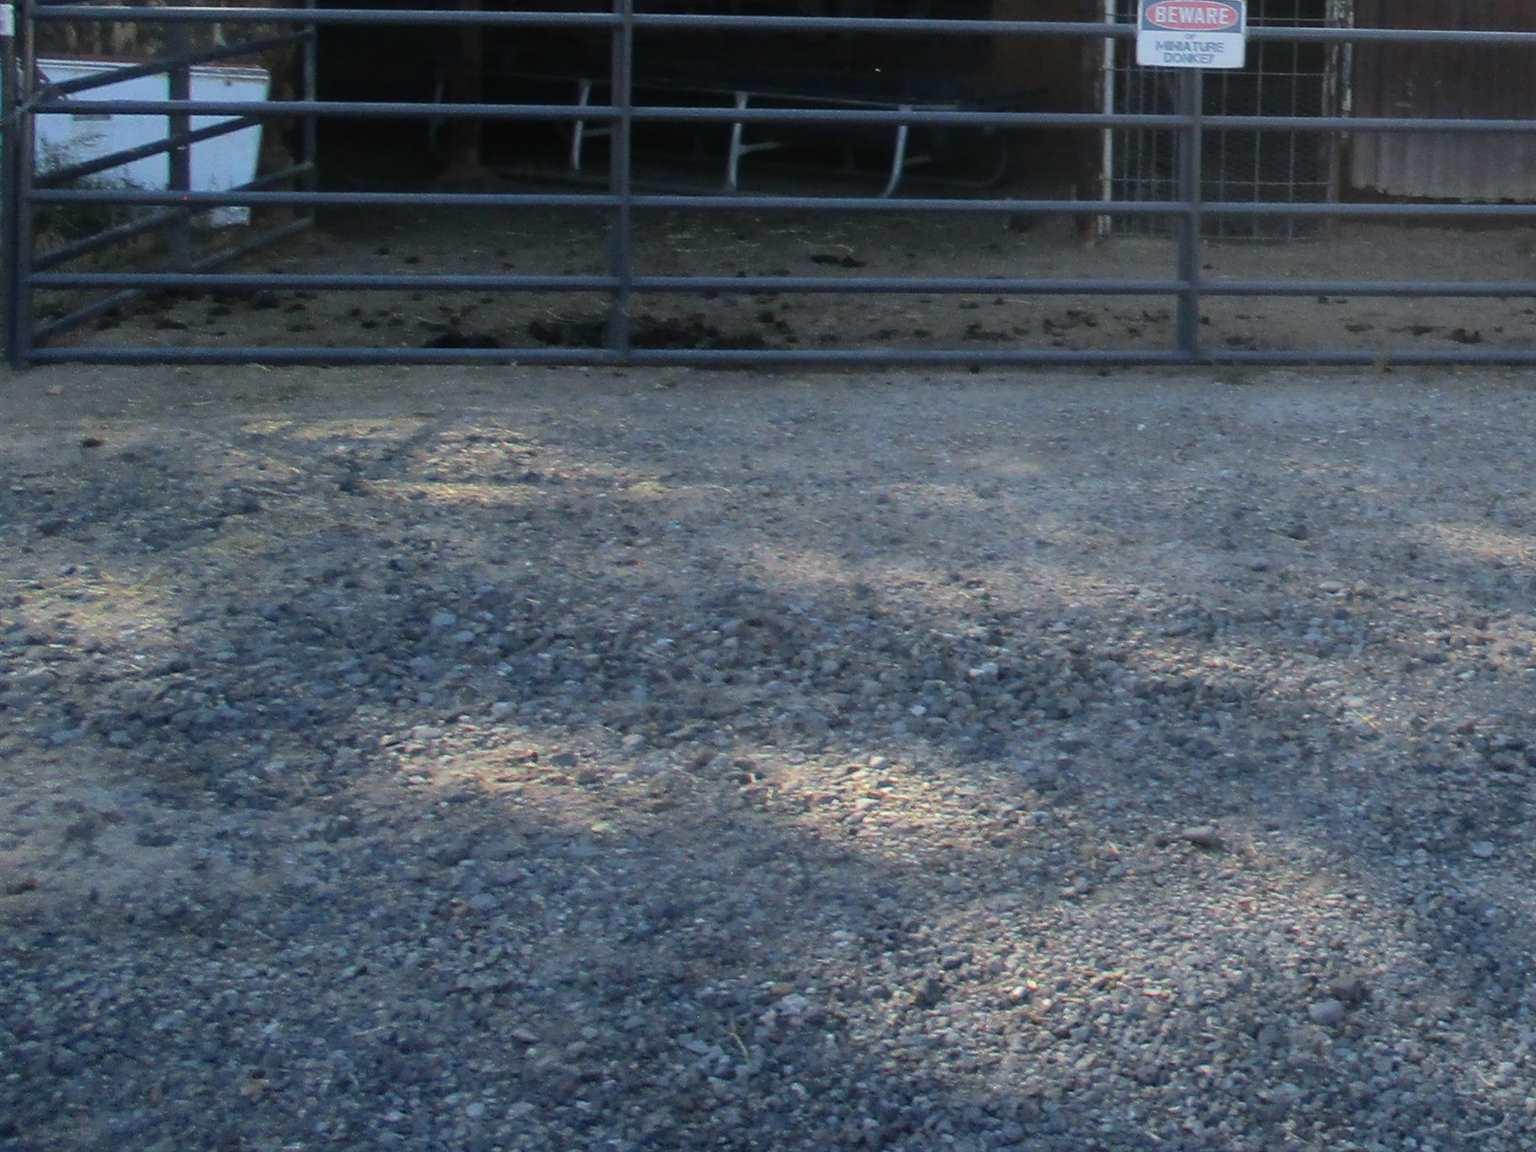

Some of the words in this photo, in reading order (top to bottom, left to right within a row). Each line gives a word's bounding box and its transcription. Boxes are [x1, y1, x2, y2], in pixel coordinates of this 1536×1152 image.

[1155, 7, 1230, 25] BEWARE
[1156, 41, 1225, 53] MINIATURE
[1163, 52, 1215, 64] DONKEY
